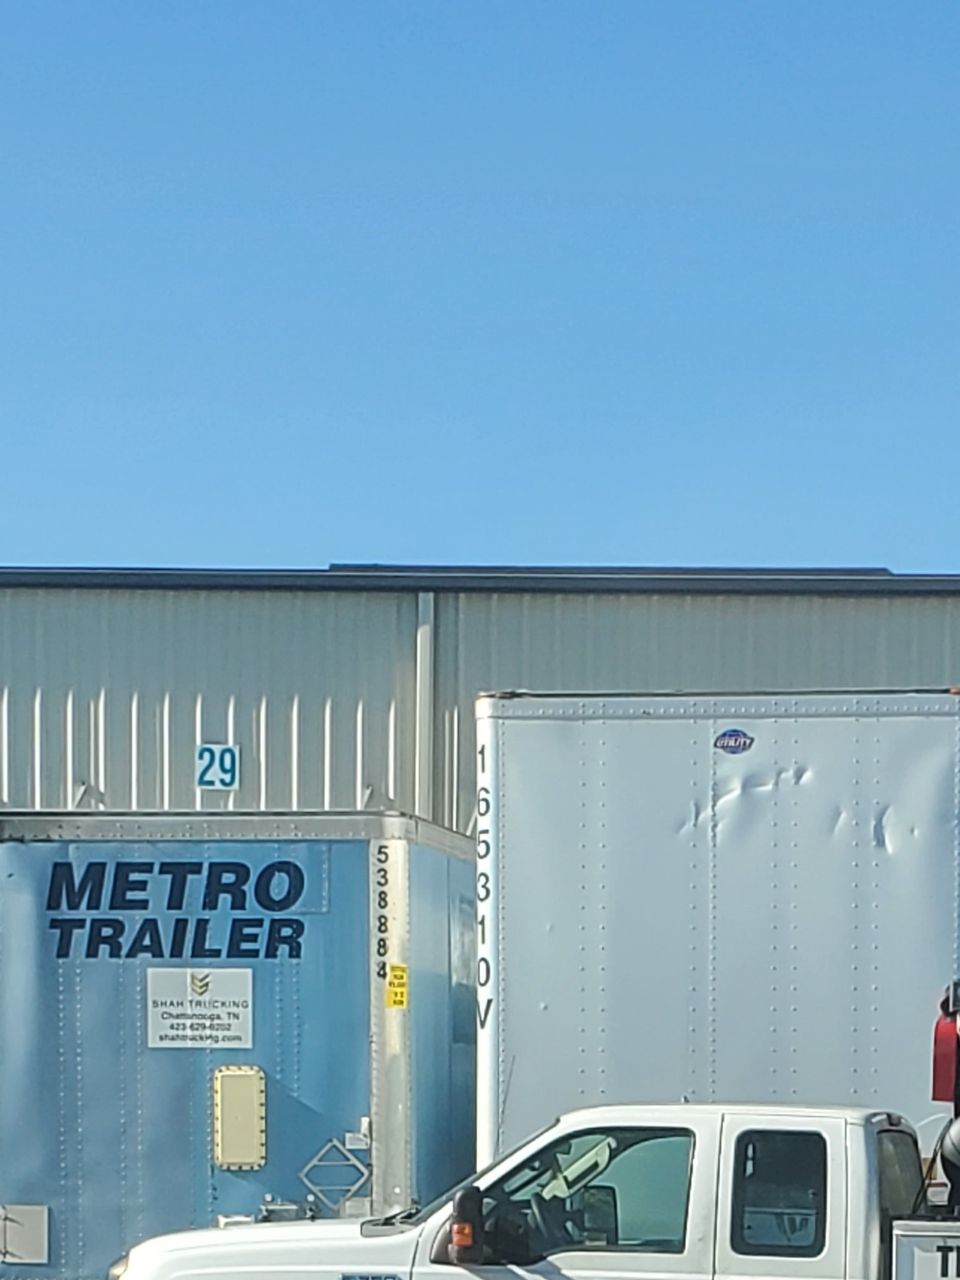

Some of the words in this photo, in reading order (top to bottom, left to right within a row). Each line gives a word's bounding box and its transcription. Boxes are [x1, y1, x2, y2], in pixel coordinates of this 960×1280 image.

[198, 747, 236, 787] 29
[46, 861, 304, 912] METRO
[477, 744, 493, 1030] 165310V
[49, 918, 304, 959] TRAILER
[152, 1000, 184, 1008] SHAH
[188, 1000, 249, 1009] TRUCKING
[227, 1012, 239, 1020] TN
